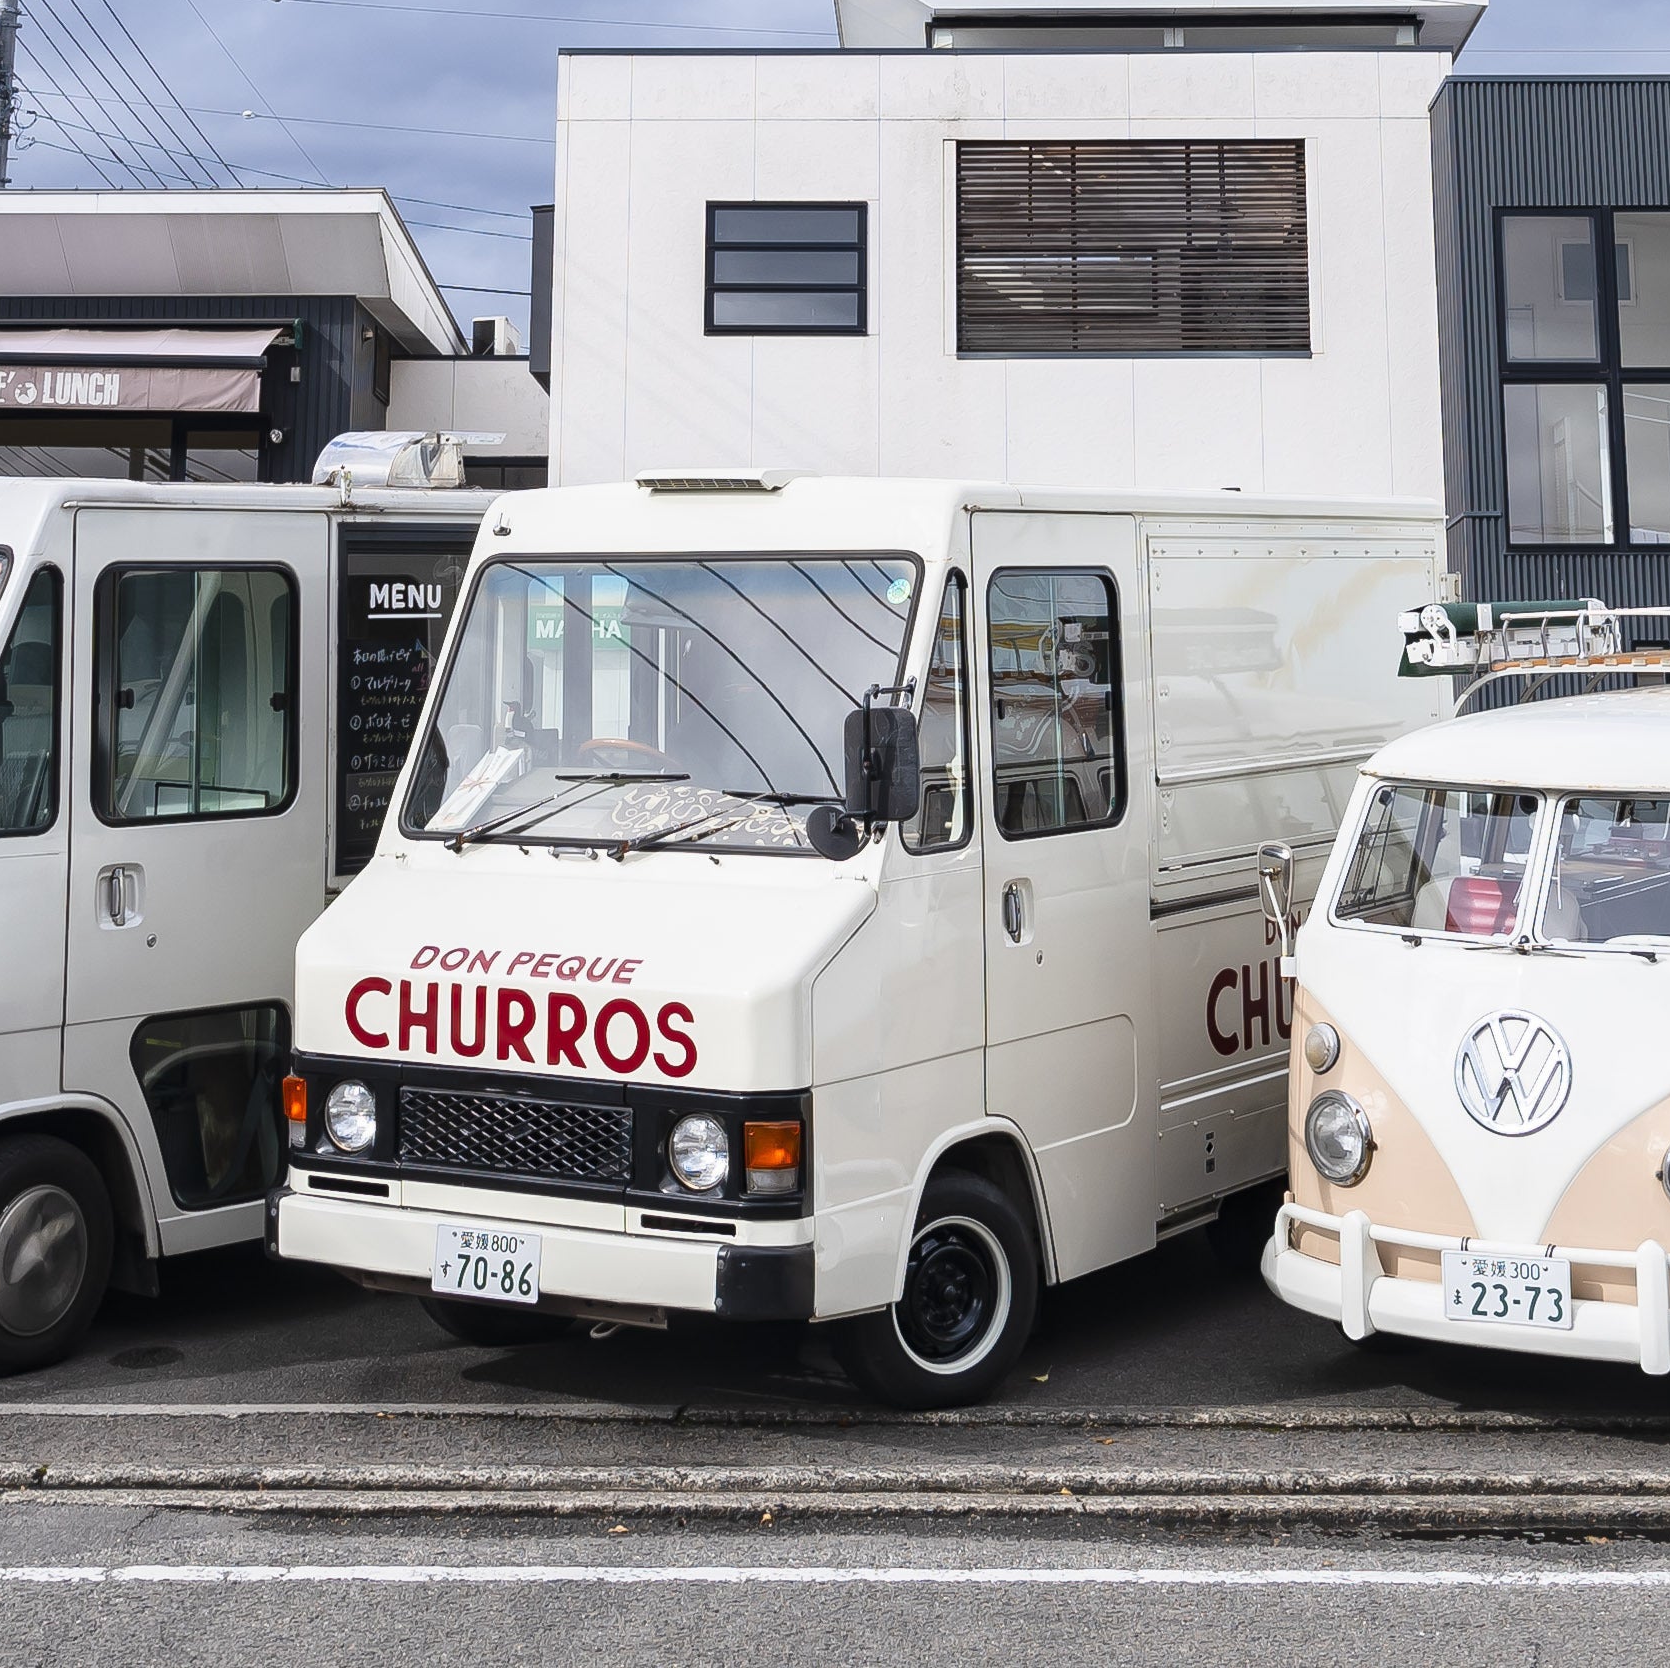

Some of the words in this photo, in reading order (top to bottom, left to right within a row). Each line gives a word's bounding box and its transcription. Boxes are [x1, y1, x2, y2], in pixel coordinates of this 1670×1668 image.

[42, 371, 120, 405] LUNCH
[369, 583, 442, 609] MENU
[409, 945, 502, 975] DON
[506, 951, 644, 985] PEQUE
[344, 976, 698, 1078] CHURROS
[457, 1253, 533, 1296] 70-86
[1470, 1281, 1563, 1323] 23-73
